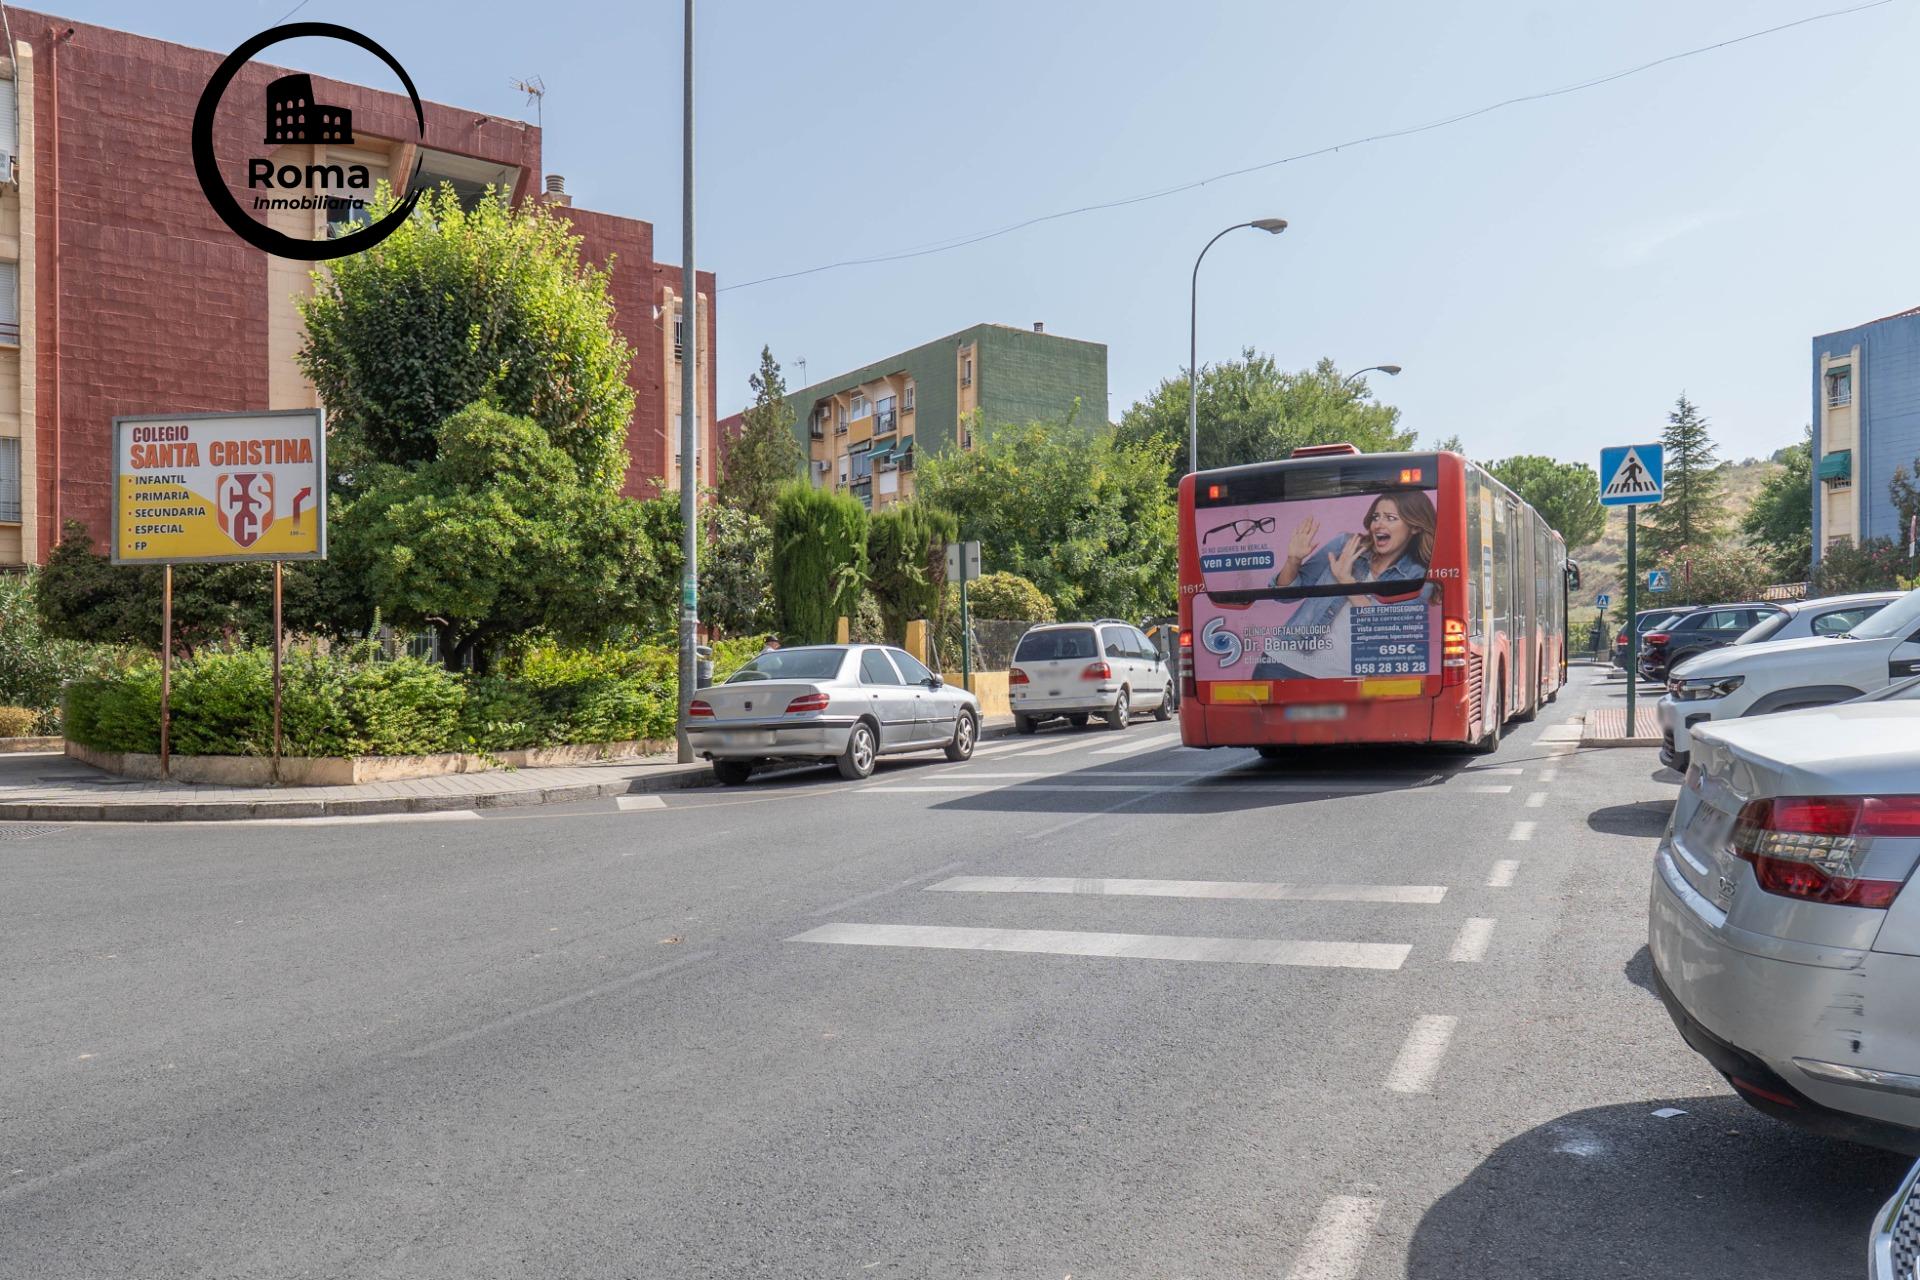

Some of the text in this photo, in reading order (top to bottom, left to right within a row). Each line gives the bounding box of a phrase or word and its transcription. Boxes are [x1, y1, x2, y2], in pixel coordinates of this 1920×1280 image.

[132, 425, 189, 443] COLEGIO
[130, 438, 313, 469] SANTA CRISTINA
[135, 474, 187, 485] INFANTIL
[135, 491, 190, 501] PRIMARIA
[134, 506, 206, 518] SECUNDARIA
[135, 524, 184, 535] ESPECIAL
[135, 541, 147, 550] FP
[1203, 555, 1271, 568] ven a vernos
[1428, 567, 1460, 578] 11612
[1244, 636, 1333, 652] Dr. Benavides
[1379, 644, 1416, 655] 695€
[1354, 662, 1426, 673] 958 28 38 28
